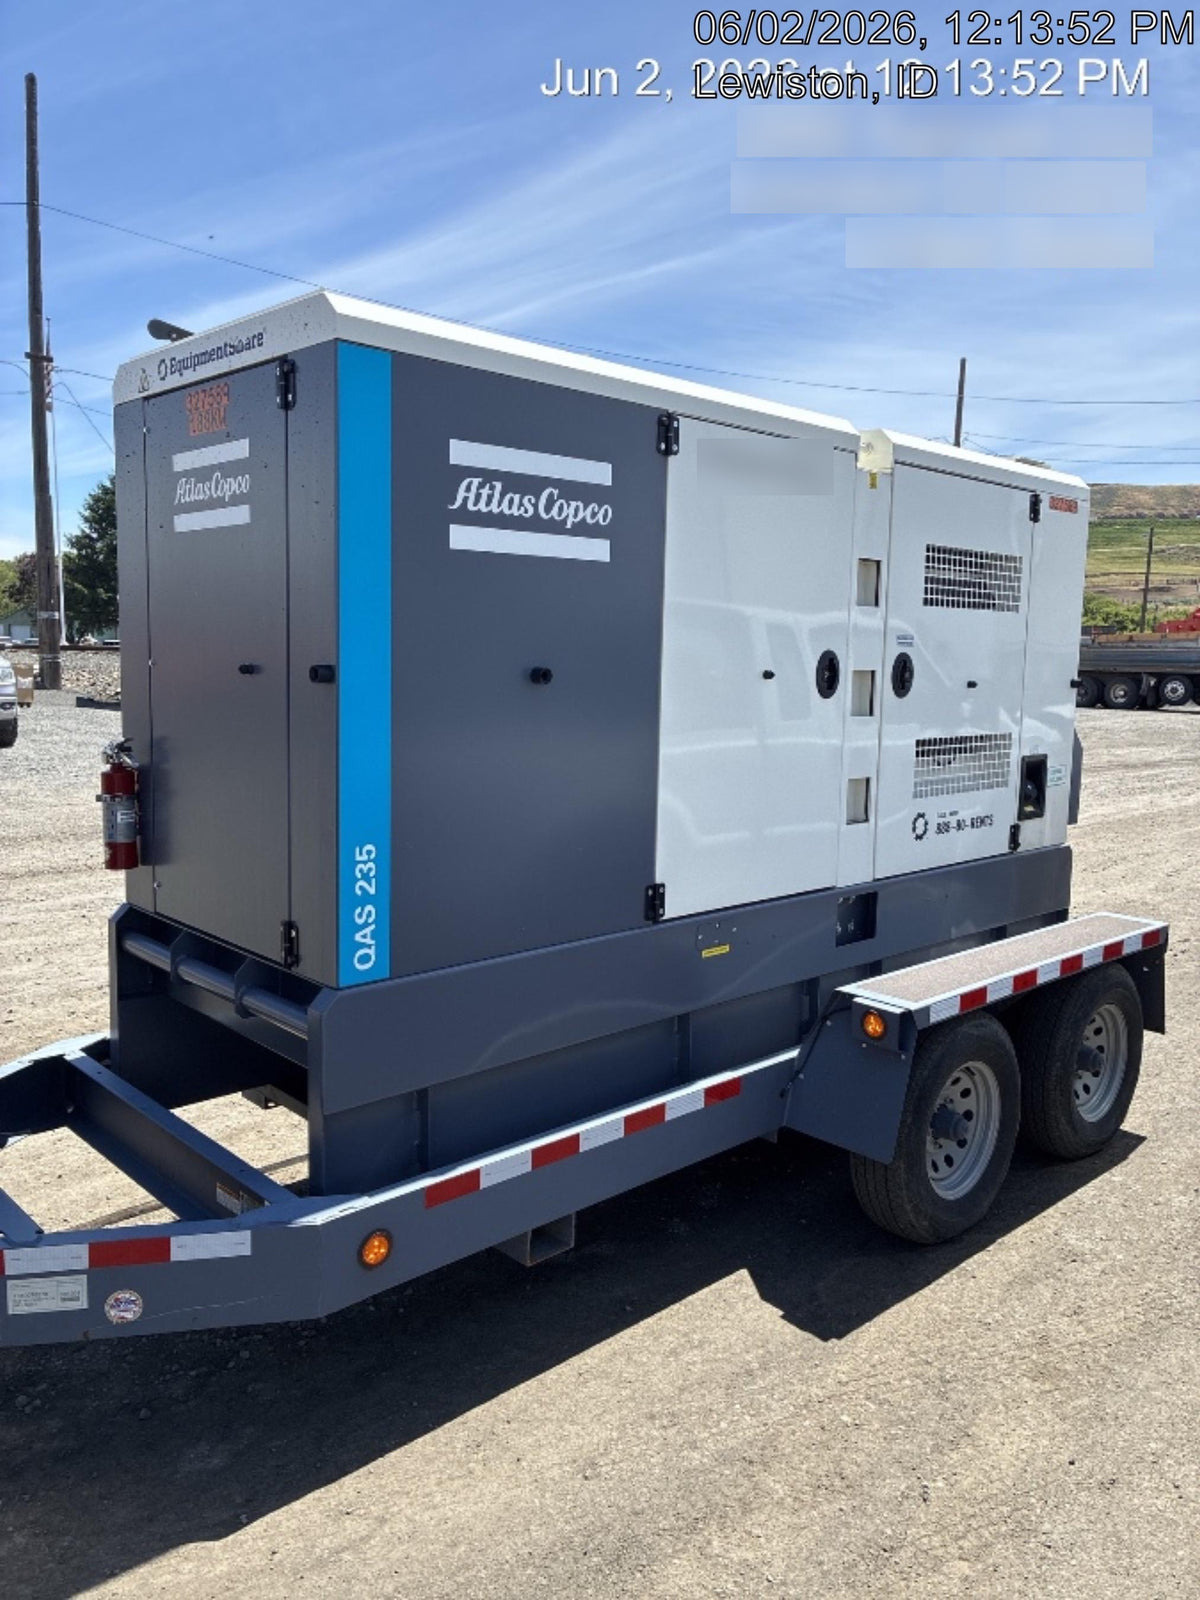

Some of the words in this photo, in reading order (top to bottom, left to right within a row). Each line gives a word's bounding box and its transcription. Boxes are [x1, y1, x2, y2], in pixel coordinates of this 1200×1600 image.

[174, 477, 210, 505] Atlas
[211, 471, 250, 502] Copco
[448, 477, 536, 518] Atlas
[537, 486, 613, 529] Copco
[354, 843, 377, 897] 235
[353, 904, 377, 971] QAS
